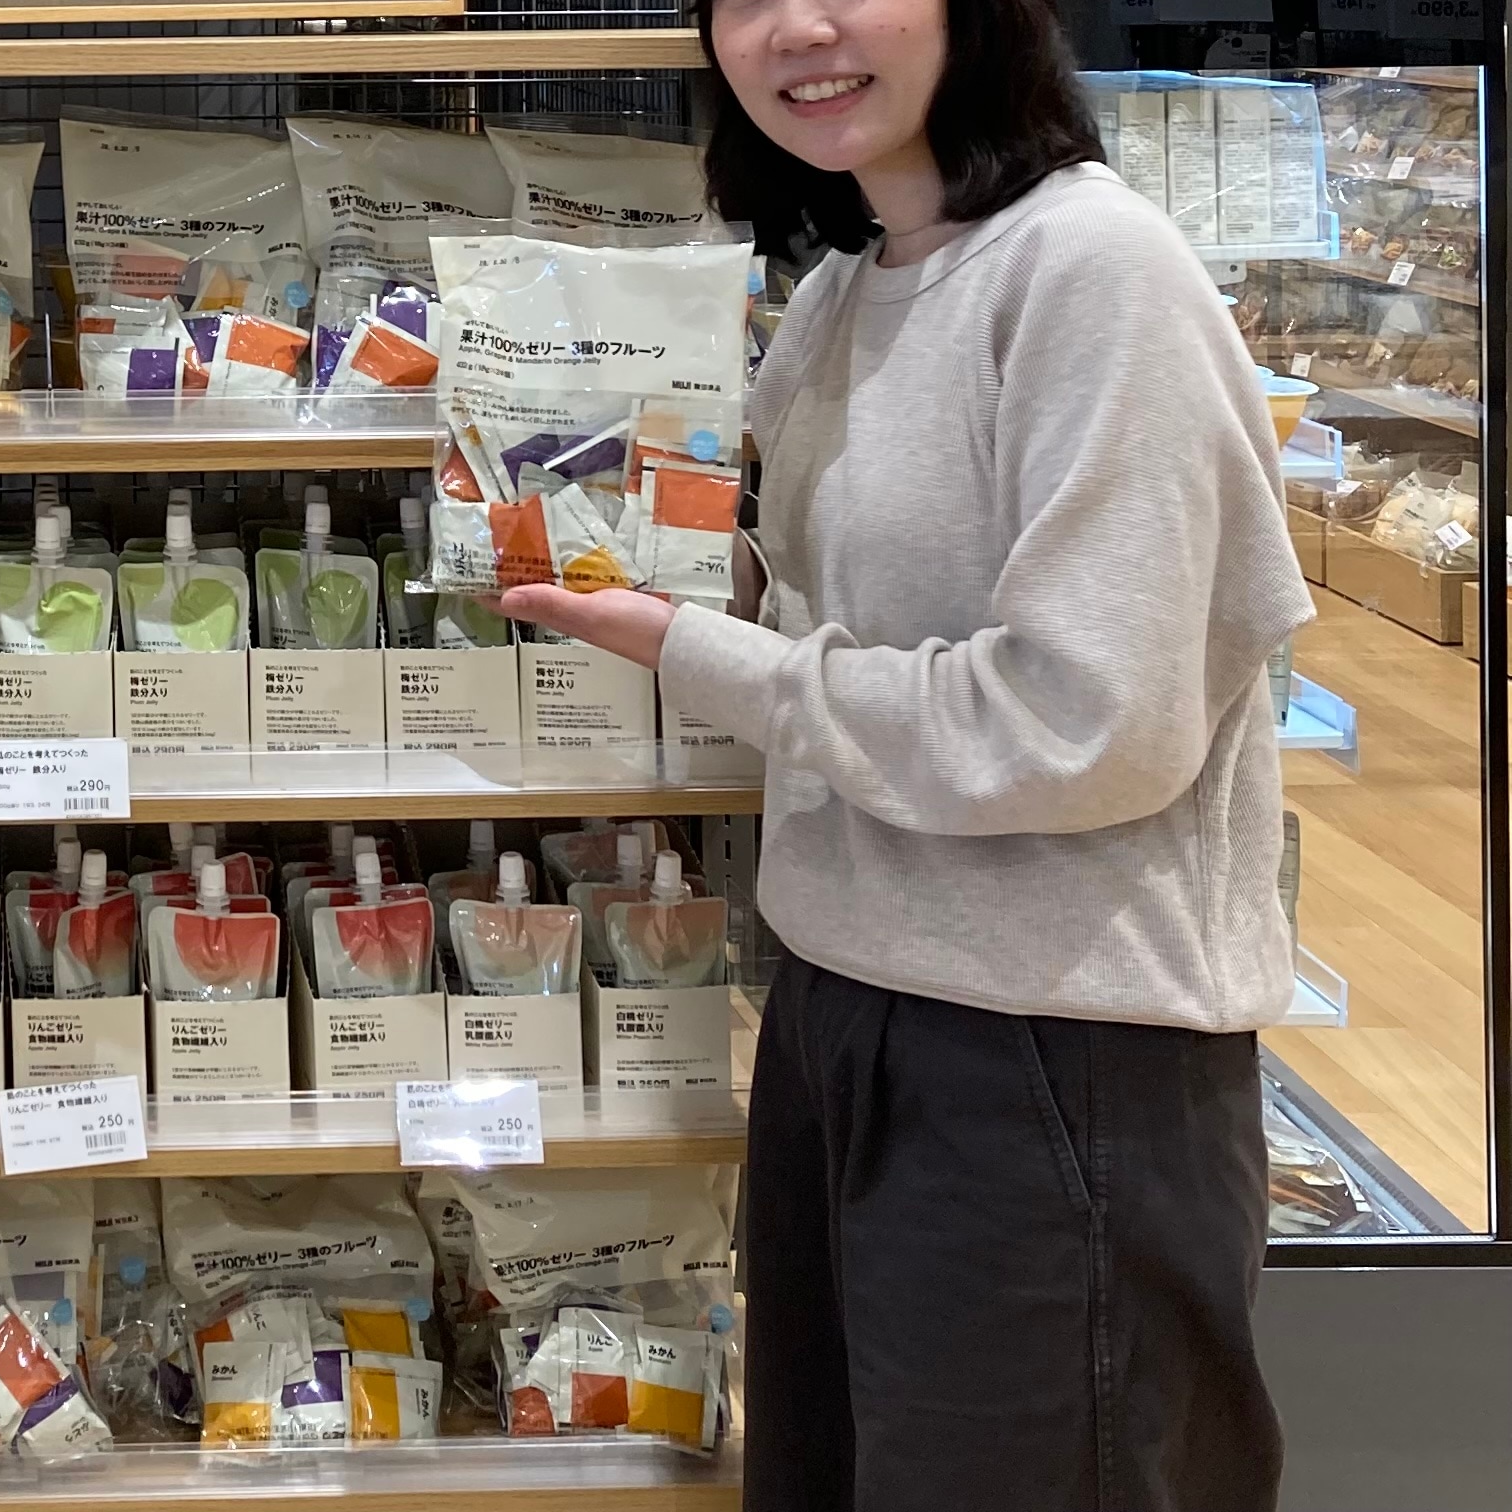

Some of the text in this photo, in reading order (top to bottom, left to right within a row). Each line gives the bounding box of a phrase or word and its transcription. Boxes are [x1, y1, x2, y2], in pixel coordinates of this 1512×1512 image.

[329, 194, 417, 214] 果汁100%ゼリー
[621, 208, 703, 223] 3種のフルーツ
[180, 220, 264, 234] 3種のフルーツ
[460, 329, 666, 359] 果汁100%ゼリー 3種のフルーツ
[28, 1022, 83, 1032] りんごゼリー
[172, 1025, 227, 1035] りんごゼリー
[330, 1021, 385, 1032] りんごゼリー
[7, 1101, 52, 1114] りんごゼリー
[99, 1114, 123, 1128] 250
[498, 1118, 523, 1131] 250
[298, 1235, 377, 1260] 3種のフルーツ
[592, 1235, 674, 1259] 3種のフルーツ
[588, 1334, 613, 1348] りんご
[648, 1344, 676, 1359] みかん
[211, 1364, 238, 1375] みかん
